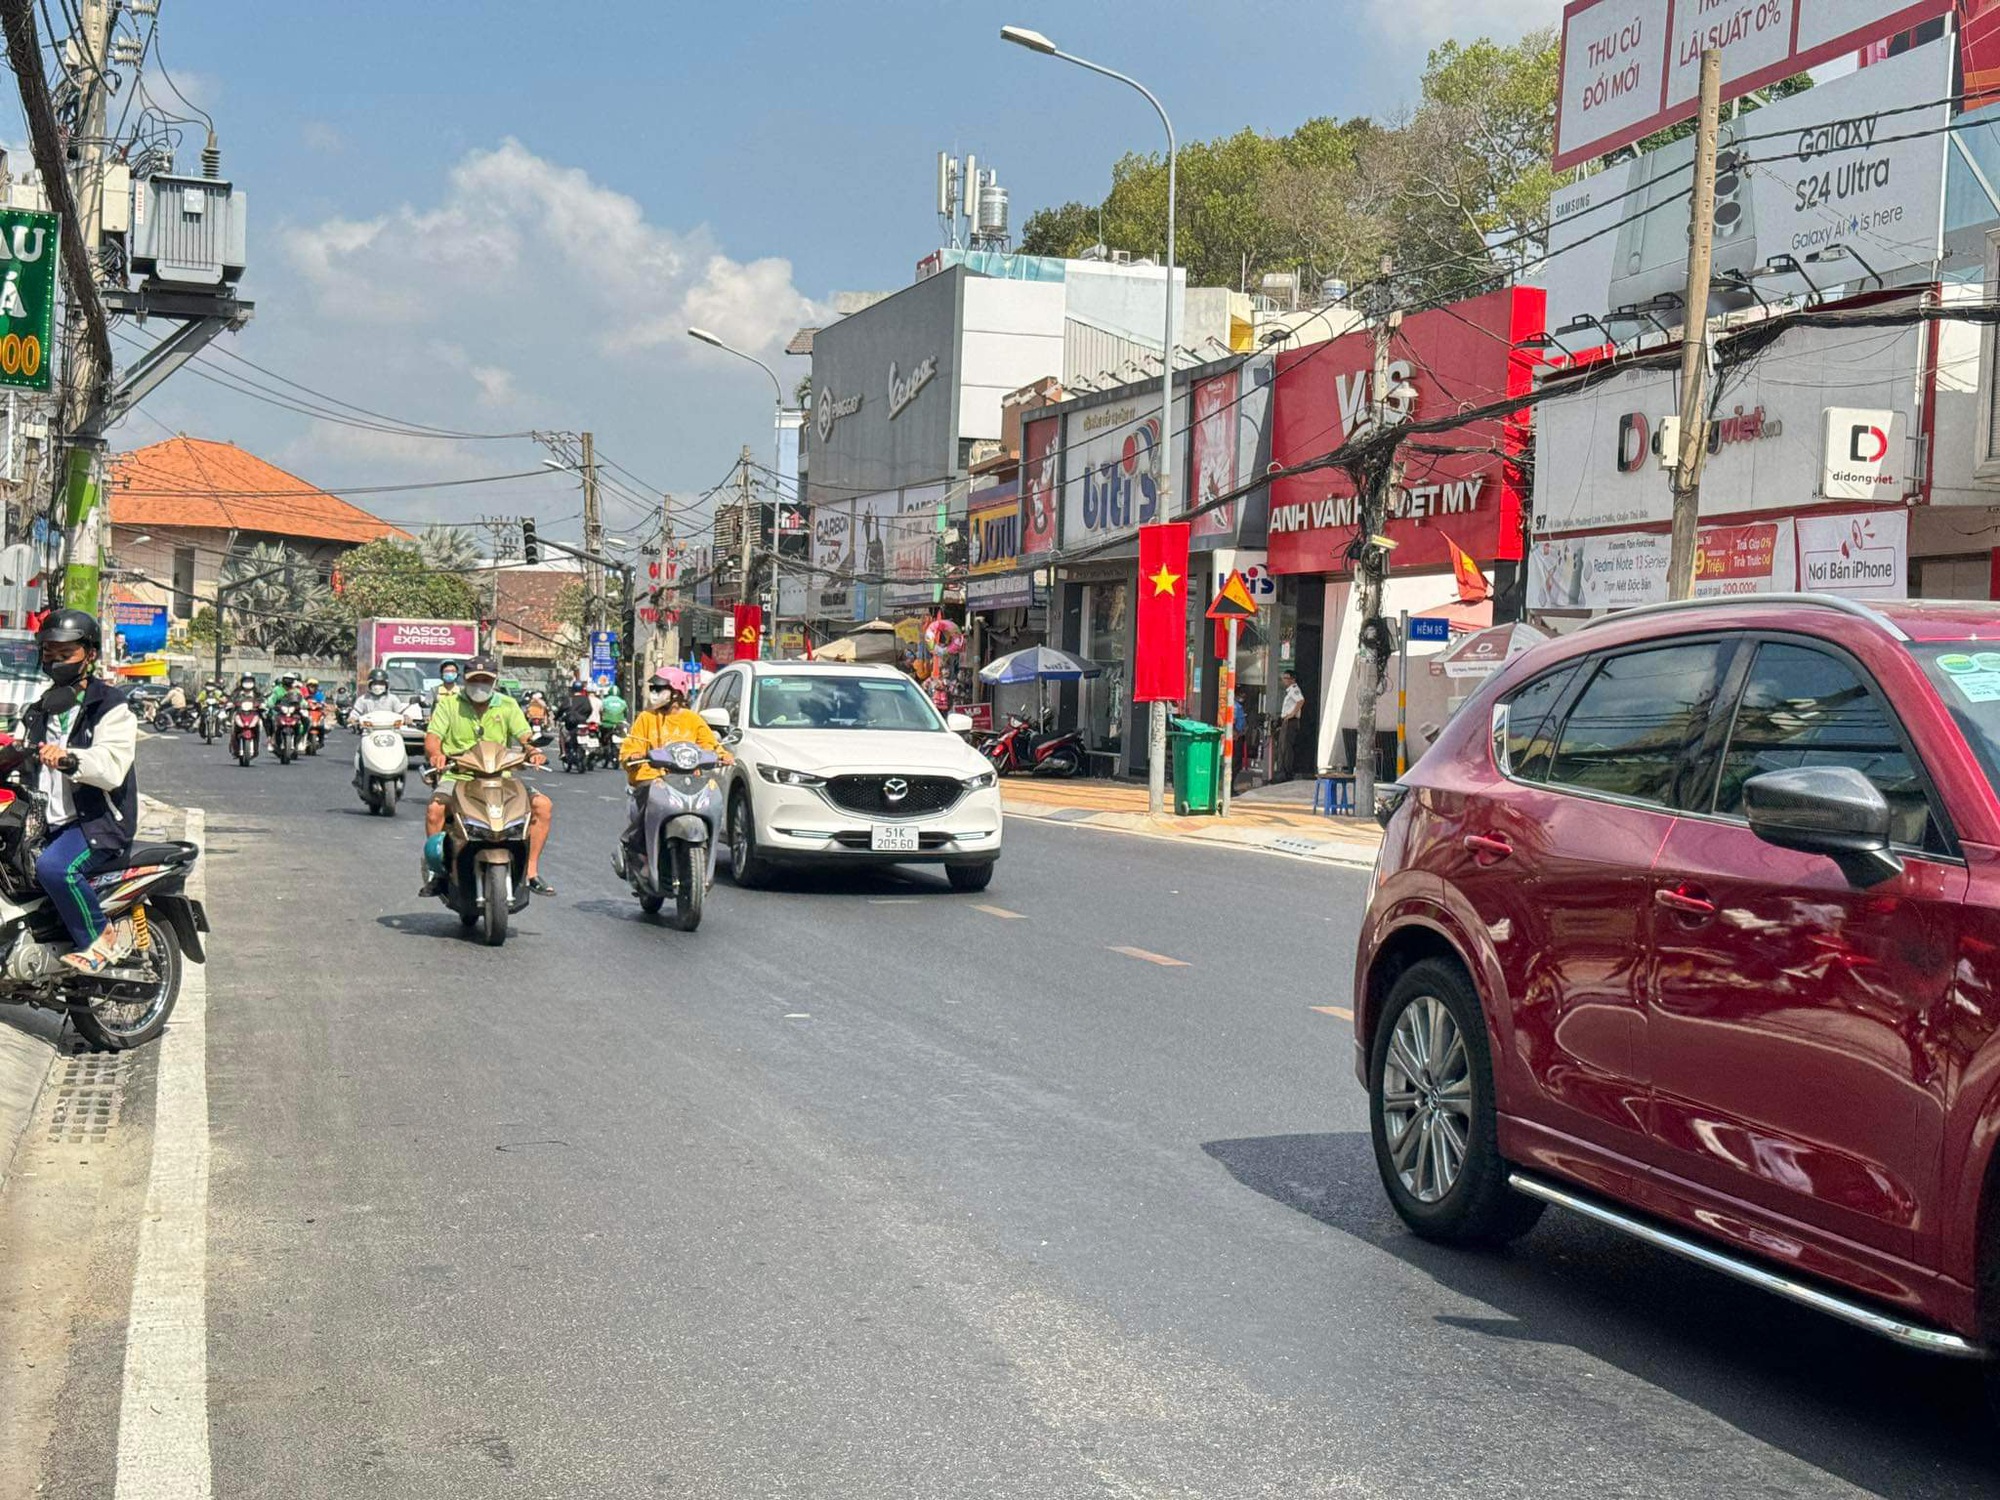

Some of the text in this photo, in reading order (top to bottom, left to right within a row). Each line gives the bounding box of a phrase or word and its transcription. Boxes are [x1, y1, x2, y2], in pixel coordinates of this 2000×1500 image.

[1708, 6, 1752, 49] SUẤT
[1756, 0, 1781, 31] 0%
[1588, 18, 1642, 69] THU CŨ
[1583, 62, 1640, 111] ĐỔI MỚI
[1798, 114, 1878, 162] Galaxy
[1795, 157, 1890, 212] S24 Ultra
[1556, 193, 1590, 218] SAMSUNG
[1791, 225, 1832, 250] Galaxy
[1859, 212, 1870, 231] is
[1872, 206, 1903, 228] here
[0, 333, 40, 376] 00
[1269, 502, 1308, 533] ANH
[1442, 472, 1486, 515] MỸ
[1536, 514, 1547, 530] 97
[1644, 554, 1668, 569] Series
[1706, 558, 1725, 577] Triệu
[1808, 561, 1892, 580] Nơi Bán iPhone
[398, 625, 451, 636] NASCO
[1416, 621, 1443, 636] HẺM 95
[393, 635, 456, 646] EXPRESS
[885, 827, 905, 838] 51K
[877, 839, 914, 850] 205.60
